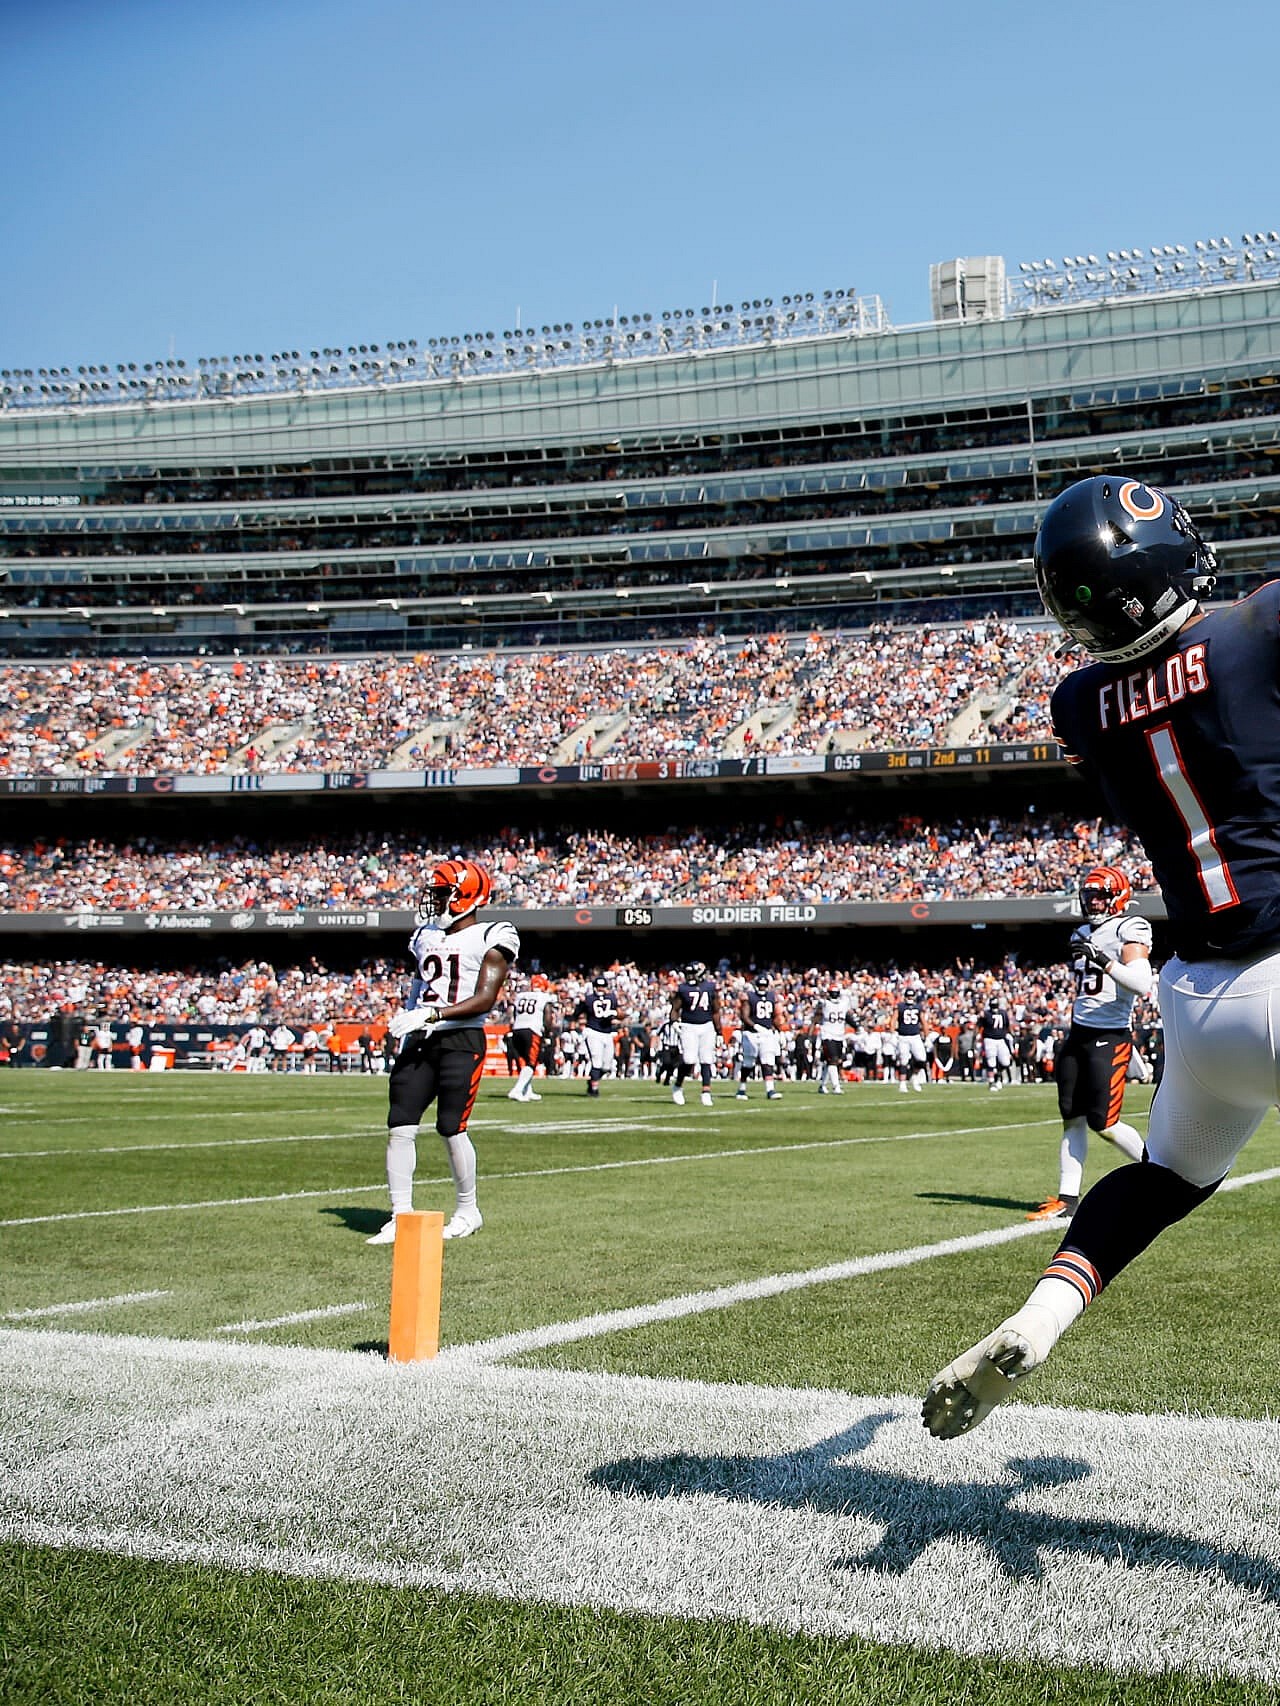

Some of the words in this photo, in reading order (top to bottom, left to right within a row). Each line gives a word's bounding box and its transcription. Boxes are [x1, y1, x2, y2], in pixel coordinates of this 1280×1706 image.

[1125, 624, 1170, 658] RACISM
[1099, 643, 1210, 730] FIELDS
[834, 755, 861, 770] 0:56
[887, 753, 907, 768] 3rd
[933, 750, 955, 766] 2nd
[975, 749, 991, 763] 11
[1032, 745, 1047, 760] 11
[658, 762, 668, 779] 3
[741, 759, 751, 775] 7
[1144, 720, 1241, 913] 1
[160, 914, 212, 929] Advocate
[318, 915, 366, 926] UNITED
[692, 907, 762, 924] SOLDIER
[770, 906, 817, 922] FIELD
[422, 953, 461, 1004] 21
[689, 991, 710, 1011] 74
[904, 1009, 919, 1025] 65
